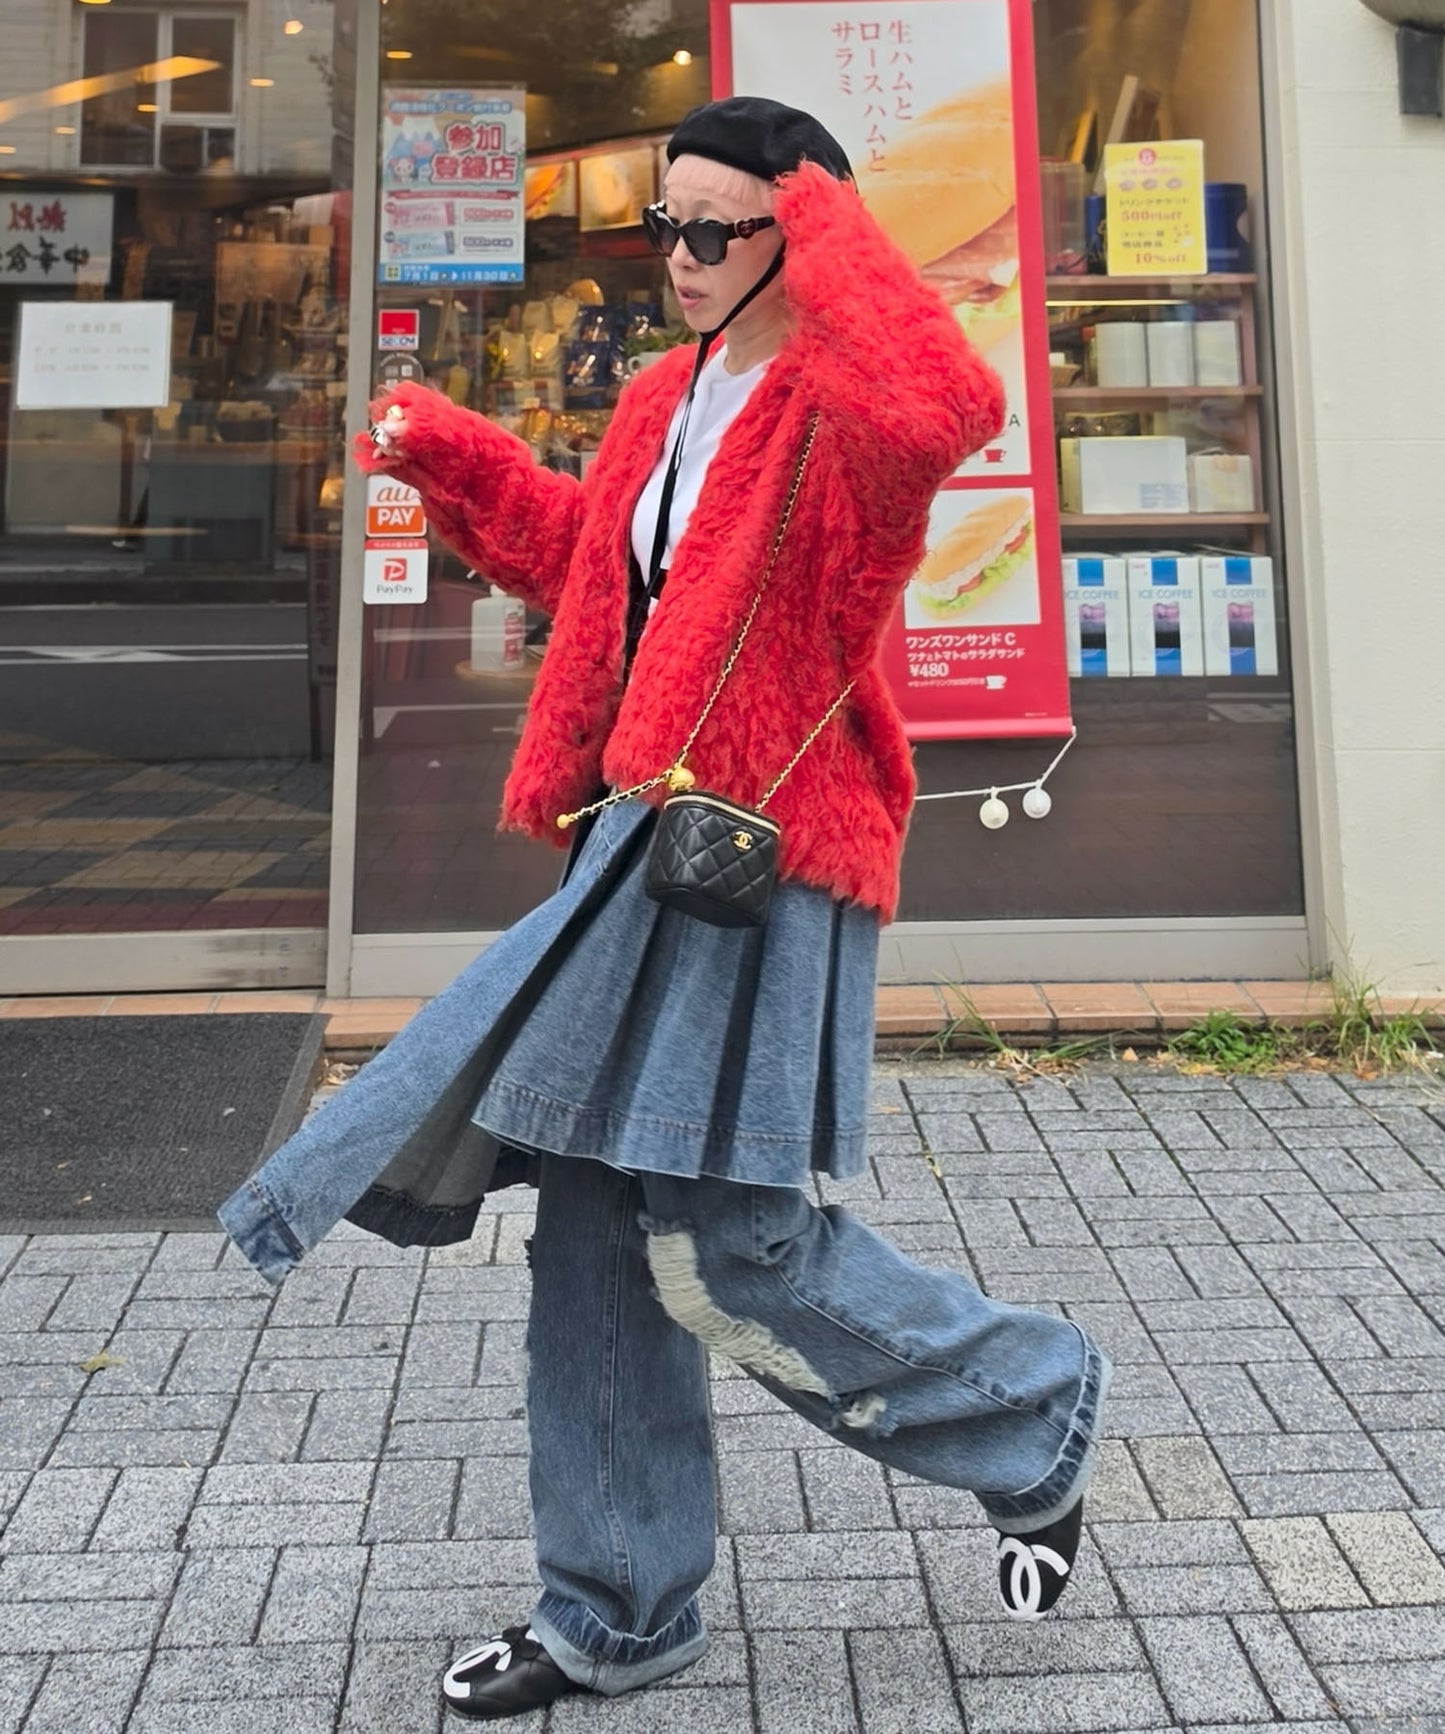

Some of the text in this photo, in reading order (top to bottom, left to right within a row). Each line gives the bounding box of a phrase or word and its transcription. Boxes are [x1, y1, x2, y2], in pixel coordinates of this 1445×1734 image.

[832, 21, 855, 95] サラミ
[889, 19, 912, 120] 生ハムと
[860, 22, 887, 172] ロースハムと
[448, 124, 503, 151] 参加
[434, 155, 516, 181] 登録店
[377, 486, 412, 503] au
[377, 508, 416, 526] PAY
[377, 584, 413, 595] PayPay
[1082, 589, 1121, 600] COFFEE
[1156, 588, 1193, 599] COFFEE
[1231, 588, 1266, 599] COFFEE
[905, 632, 1017, 650] ワンズワンサンド C
[907, 648, 1025, 662] ツナとトマトのサラダサンド
[909, 662, 949, 677] ¥480
